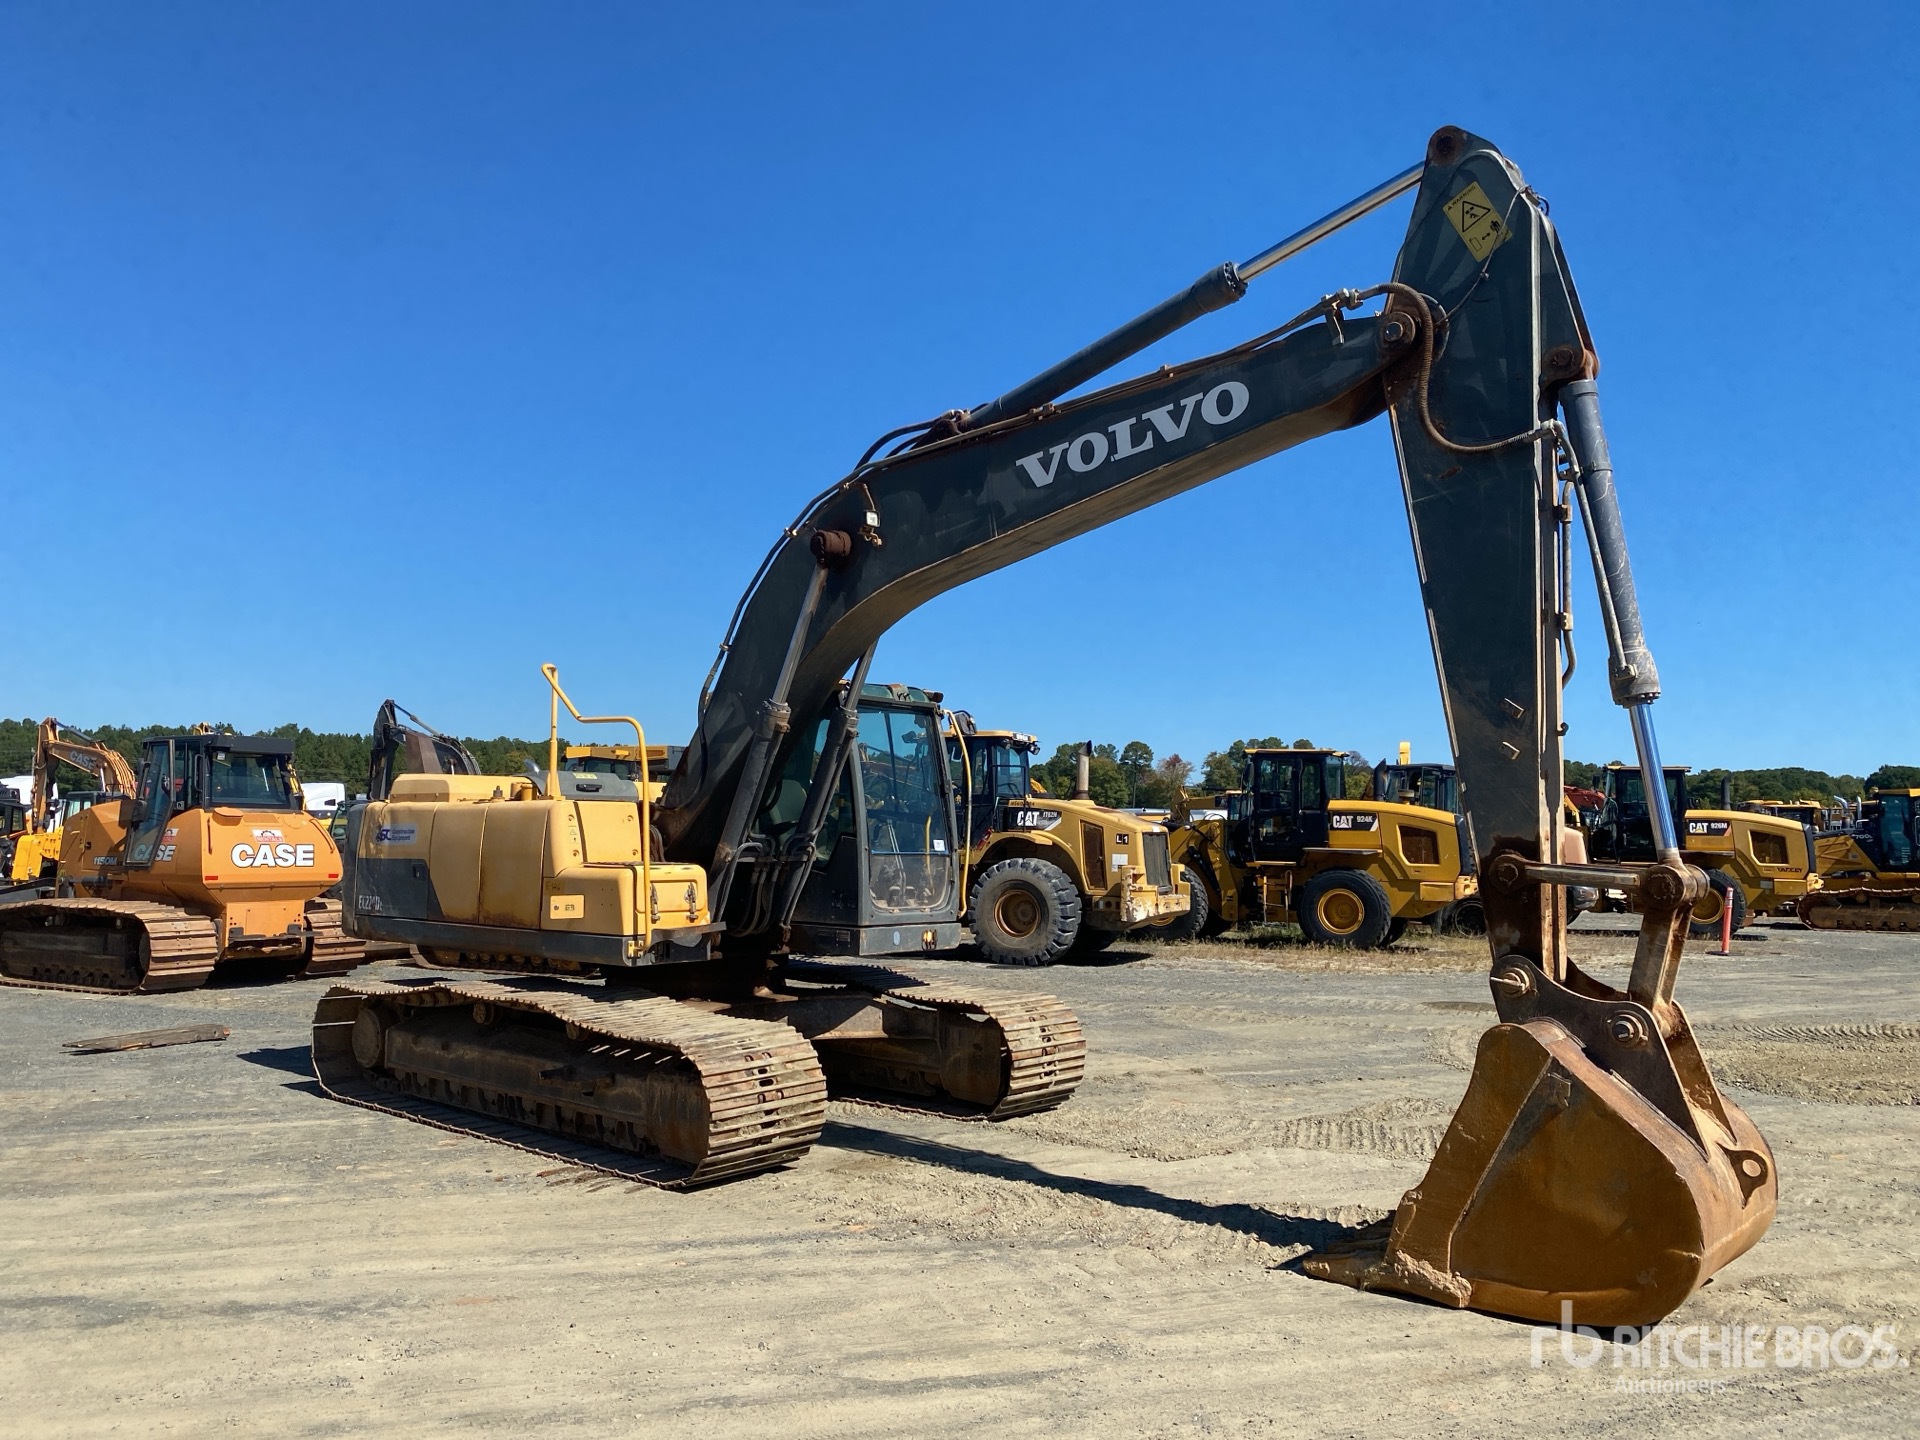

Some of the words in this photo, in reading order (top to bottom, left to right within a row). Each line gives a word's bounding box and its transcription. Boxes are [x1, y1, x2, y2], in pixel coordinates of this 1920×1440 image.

[1452, 185, 1475, 205] WARNING
[1016, 381, 1250, 488] VOLVO
[70, 750, 97, 769] CASE
[1017, 810, 1040, 826] CAT
[1332, 815, 1353, 828] CAT
[1689, 822, 1709, 834] CAT
[93, 856, 118, 866] 1150M
[231, 843, 315, 868] CASE
